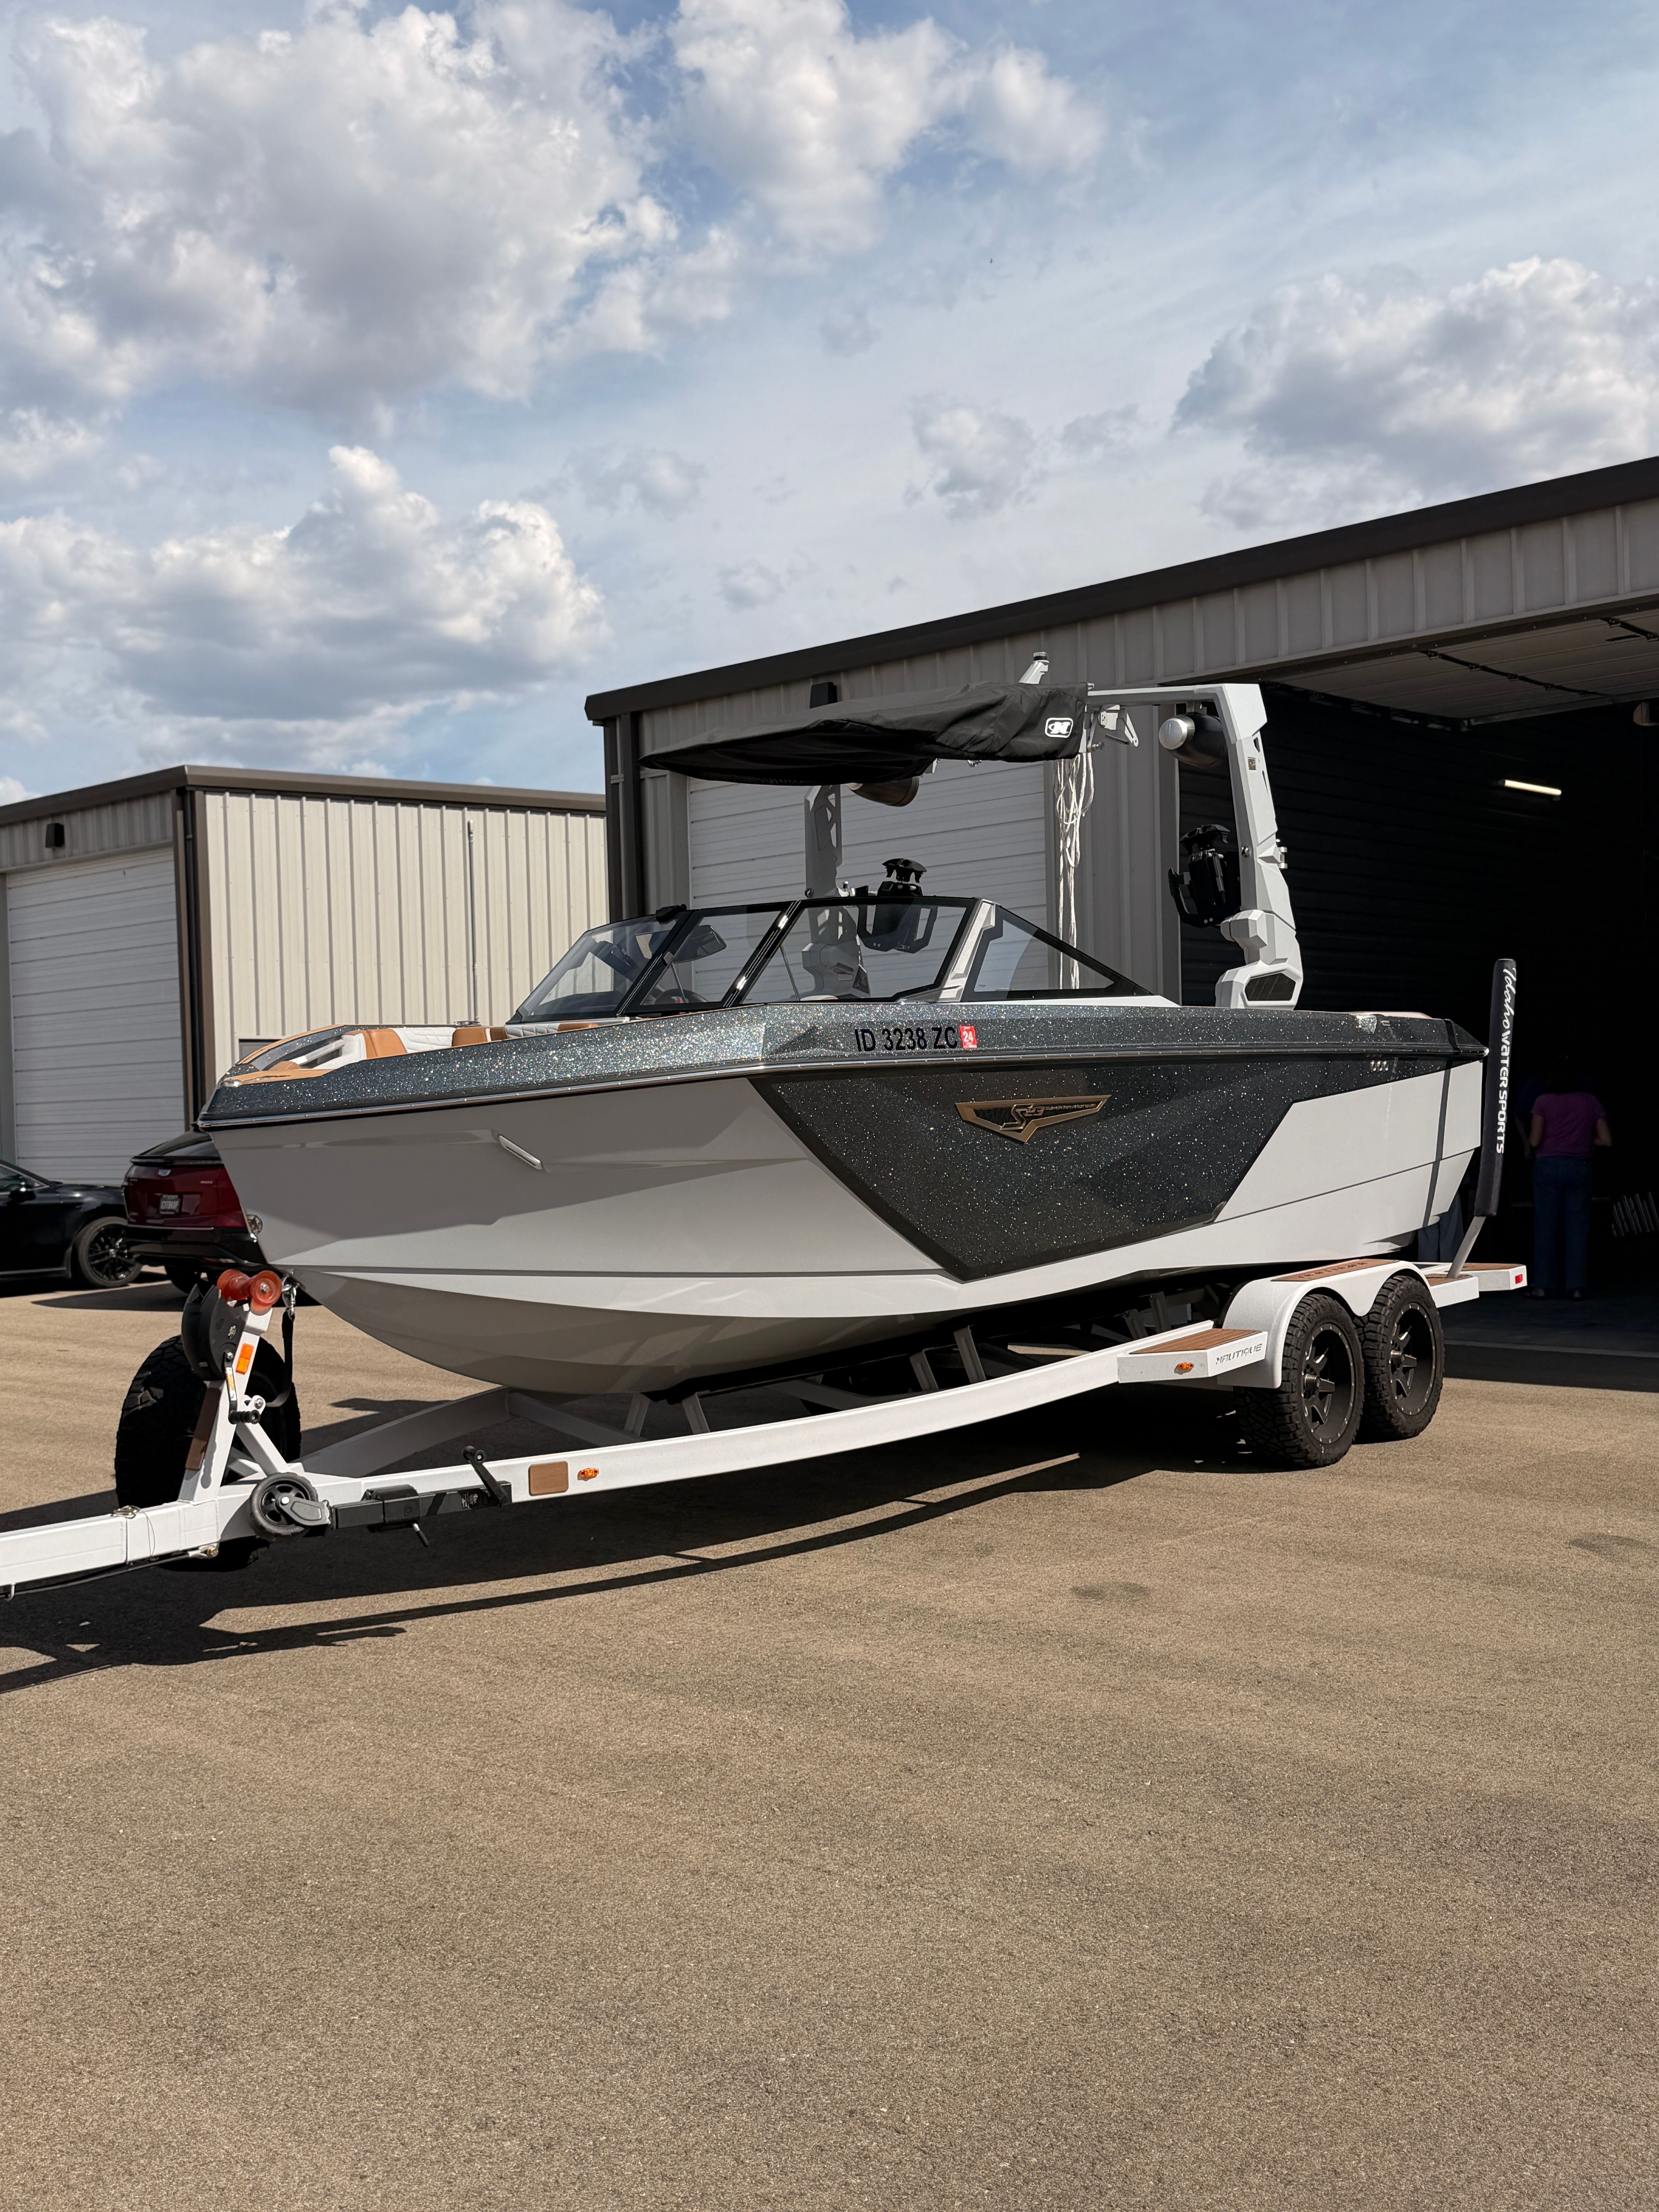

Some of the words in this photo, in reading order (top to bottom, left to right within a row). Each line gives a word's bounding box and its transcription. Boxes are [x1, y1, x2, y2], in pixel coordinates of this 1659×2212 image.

[1502, 967, 1516, 1029] Idaho
[854, 1029, 876, 1052] ID
[881, 1027, 927, 1051] 3238
[931, 1026, 958, 1049] ZC
[963, 1030, 974, 1042] 24
[1496, 1090, 1508, 1154] SPORTS
[1216, 1343, 1262, 1365] NAUTIQUE
